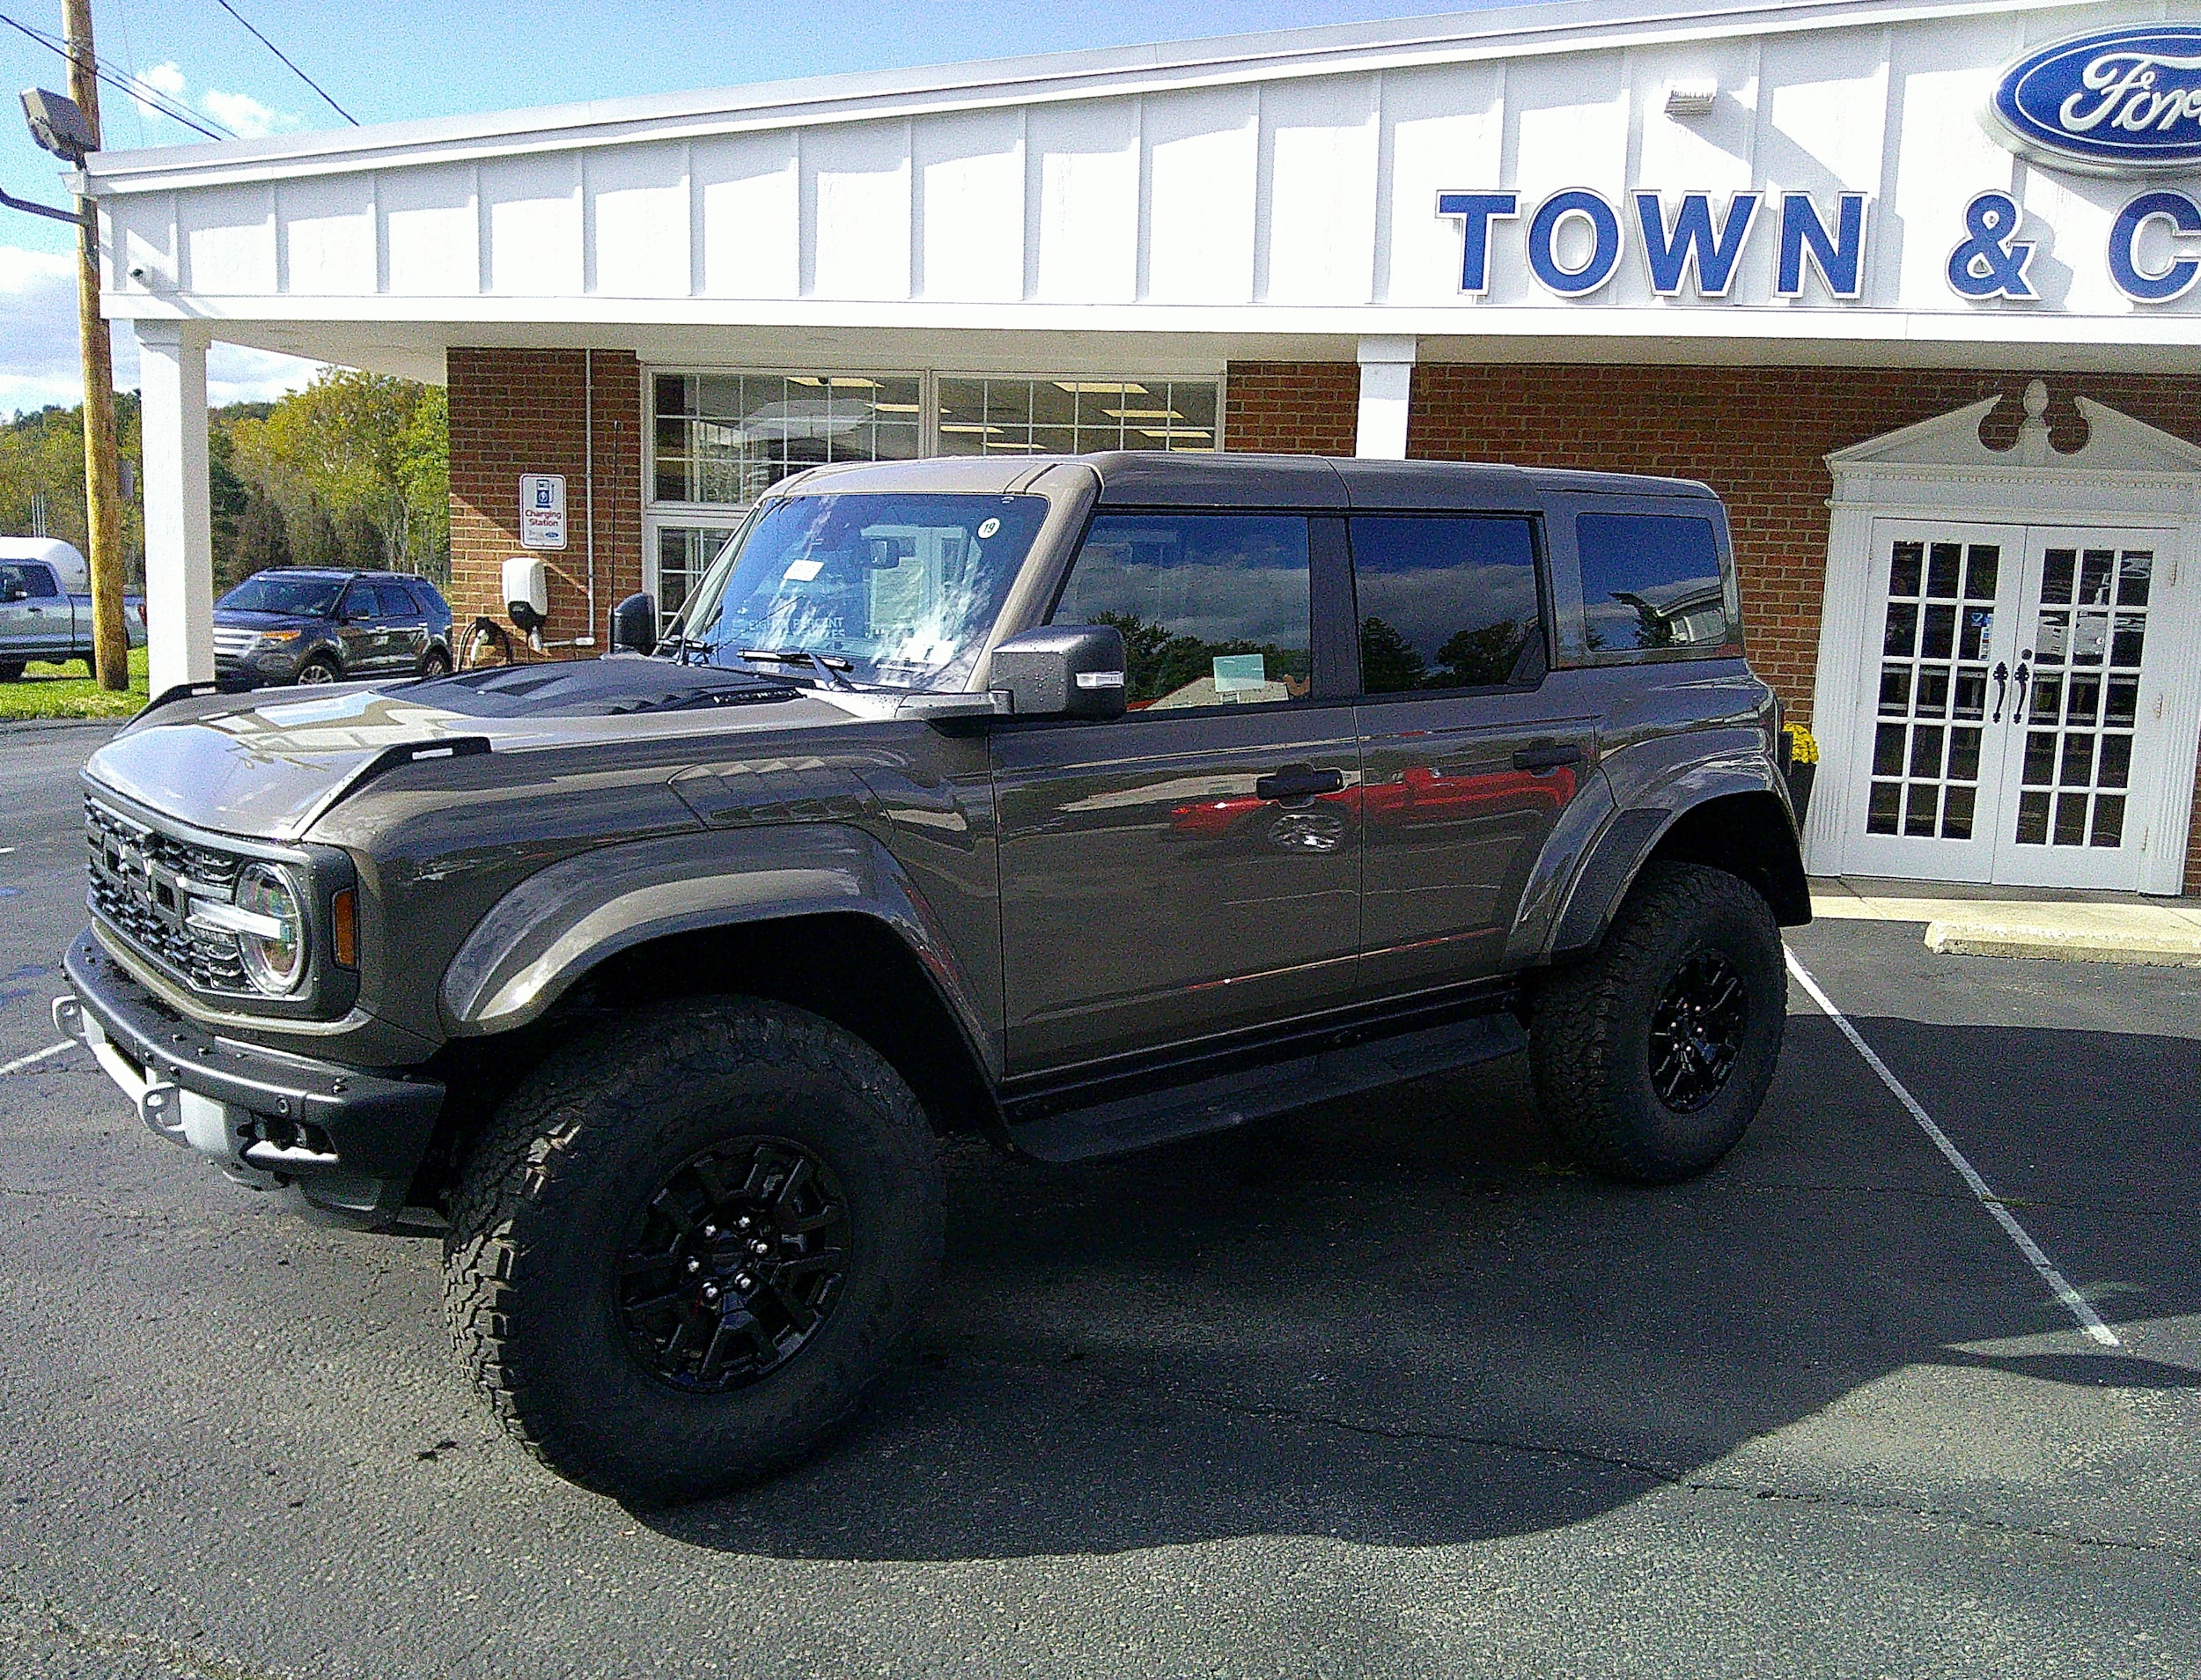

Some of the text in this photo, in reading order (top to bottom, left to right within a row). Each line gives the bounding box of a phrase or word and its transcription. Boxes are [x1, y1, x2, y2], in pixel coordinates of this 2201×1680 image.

[2059, 52, 2201, 132] For
[1437, 189, 1867, 298] TOWN
[1946, 190, 2041, 299] &
[526, 510, 562, 519] Charging
[983, 522, 996, 534] 19
